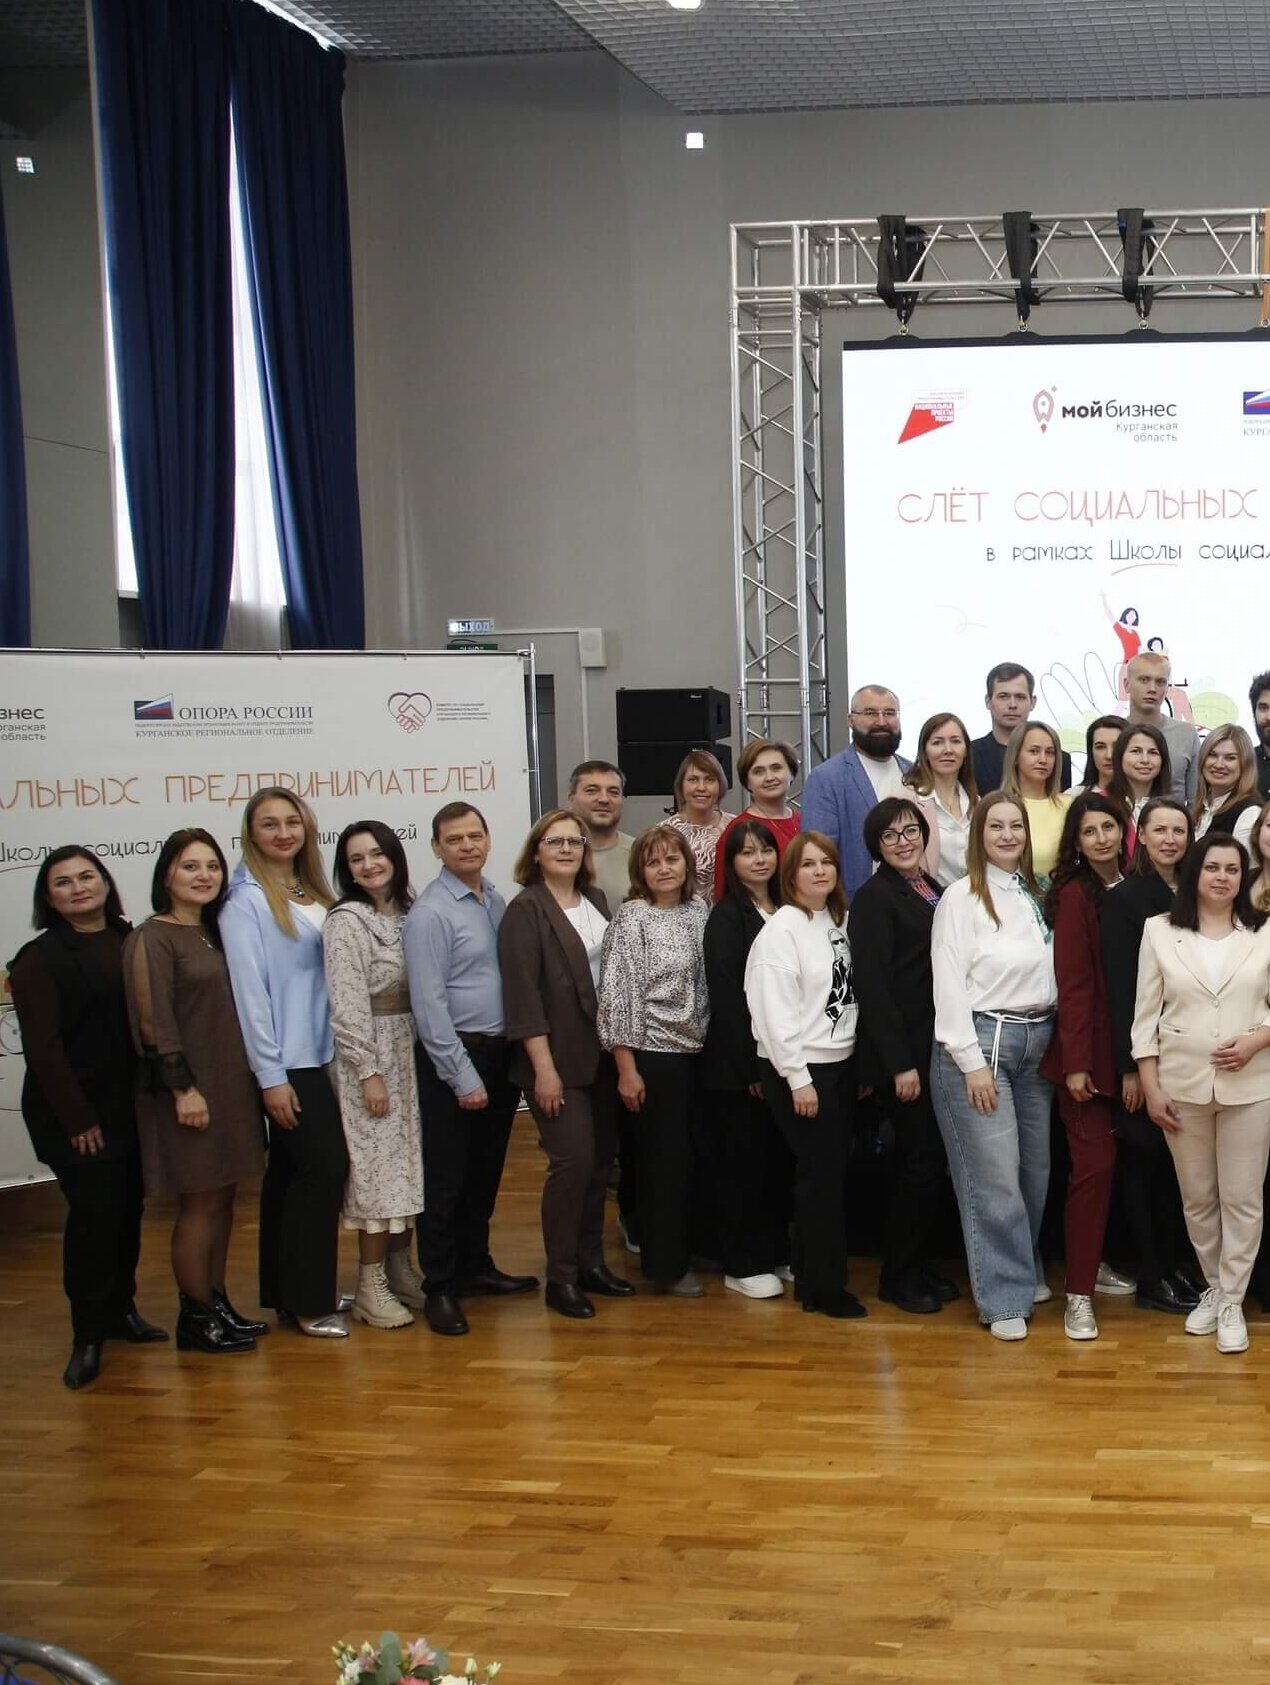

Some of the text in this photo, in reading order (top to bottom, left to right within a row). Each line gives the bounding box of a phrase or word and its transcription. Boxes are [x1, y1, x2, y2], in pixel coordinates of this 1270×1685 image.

[1116, 422, 1178, 433] Курганская
[1133, 433, 1177, 442] область
[897, 486, 990, 523] СЛЁТ
[1014, 488, 1258, 527] СОЦИАЛЬНЫХ
[986, 547, 997, 561] в
[1012, 545, 1093, 561] рамках
[1110, 539, 1182, 560] Школы
[179, 706, 312, 720] ОПОРА РОССИИ
[1, 732, 46, 741] область
[136, 730, 192, 738] КУРГАНСКОЕ
[0, 777, 141, 809] ЛЬНЫХ
